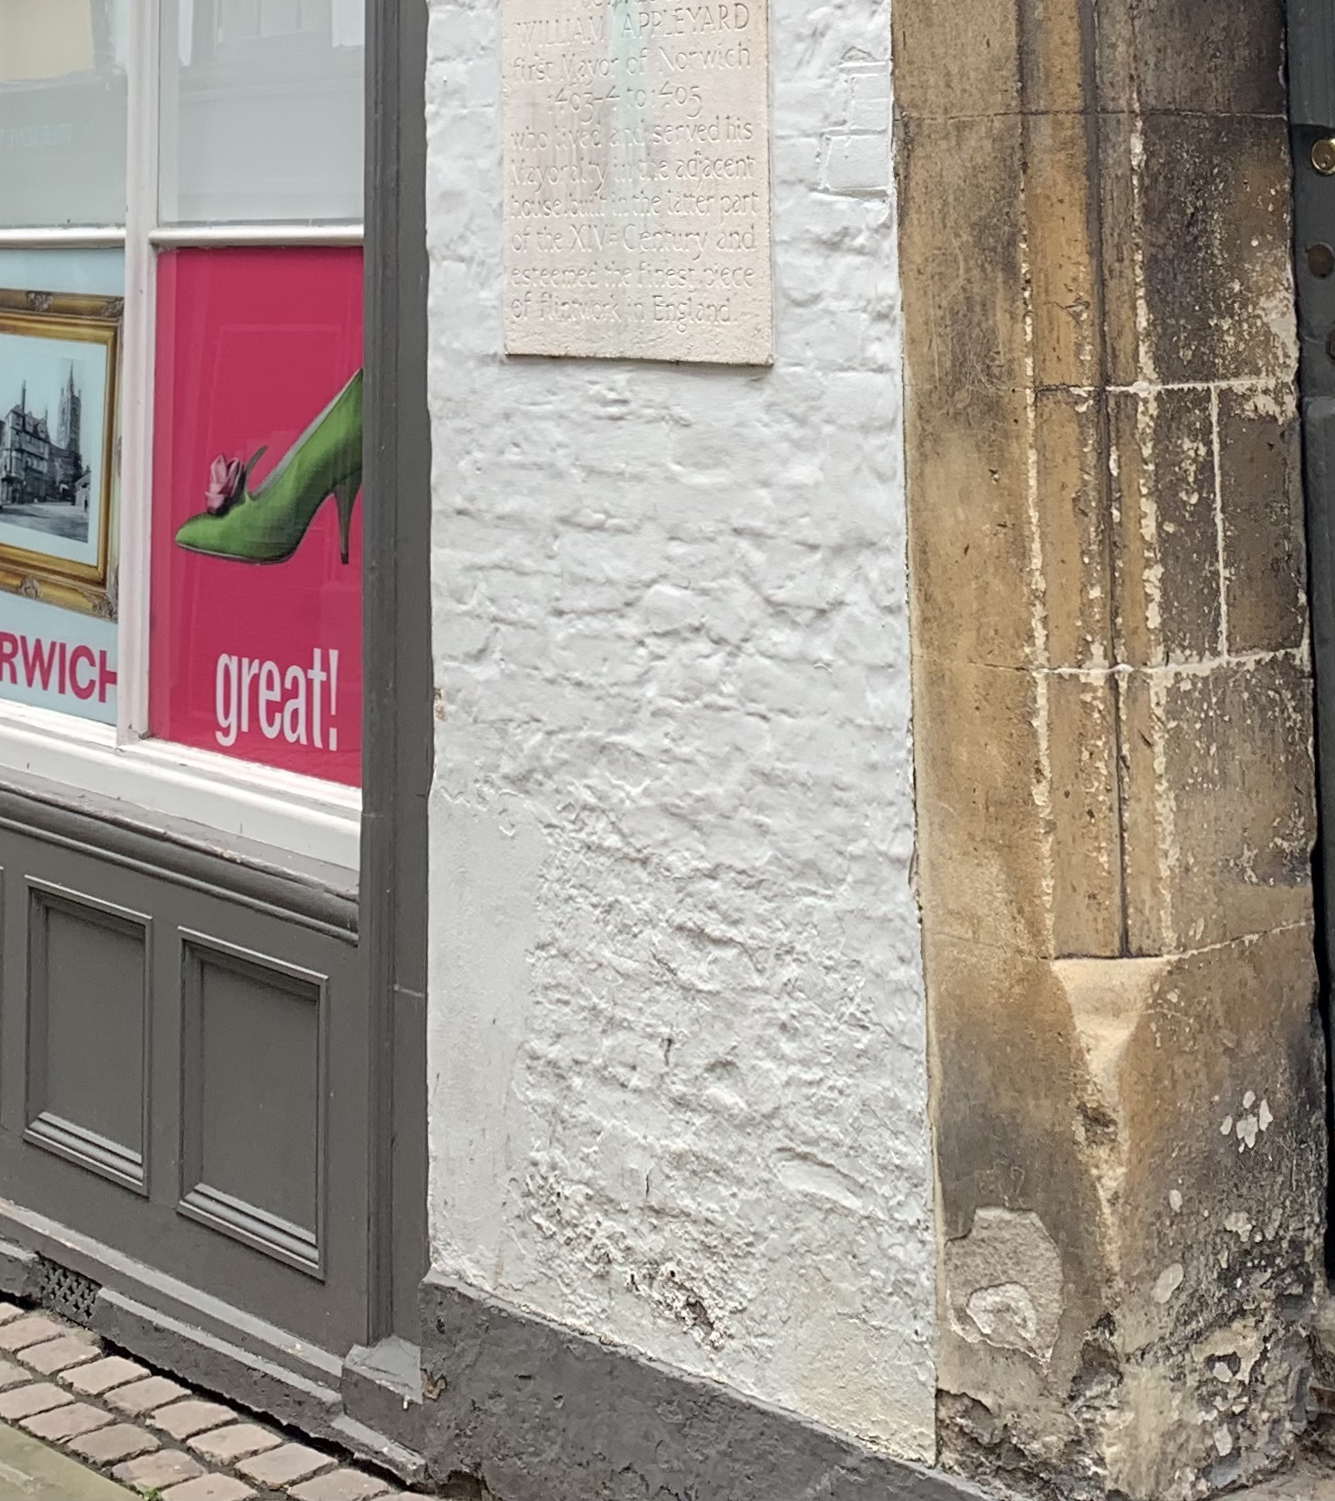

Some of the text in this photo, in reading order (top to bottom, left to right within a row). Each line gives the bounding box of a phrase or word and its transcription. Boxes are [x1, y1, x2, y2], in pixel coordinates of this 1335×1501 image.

[514, 2, 750, 47] WILLIAM APPLEYARD
[513, 40, 752, 87] first Mayor of Norwich
[510, 125, 548, 150] who
[609, 118, 646, 147] and
[652, 114, 720, 146] served
[725, 114, 754, 144] his
[639, 152, 670, 181] the
[675, 150, 756, 189] adjacent
[633, 189, 662, 216] the
[667, 189, 715, 216] latter
[720, 192, 759, 225] part
[511, 226, 531, 252] of
[537, 226, 564, 252] the
[623, 223, 708, 261] Century
[716, 224, 758, 252] and
[511, 261, 599, 288] esteemed
[604, 260, 633, 288] the
[638, 260, 695, 289] finest
[511, 290, 532, 320] of
[214, 647, 339, 752] great!
